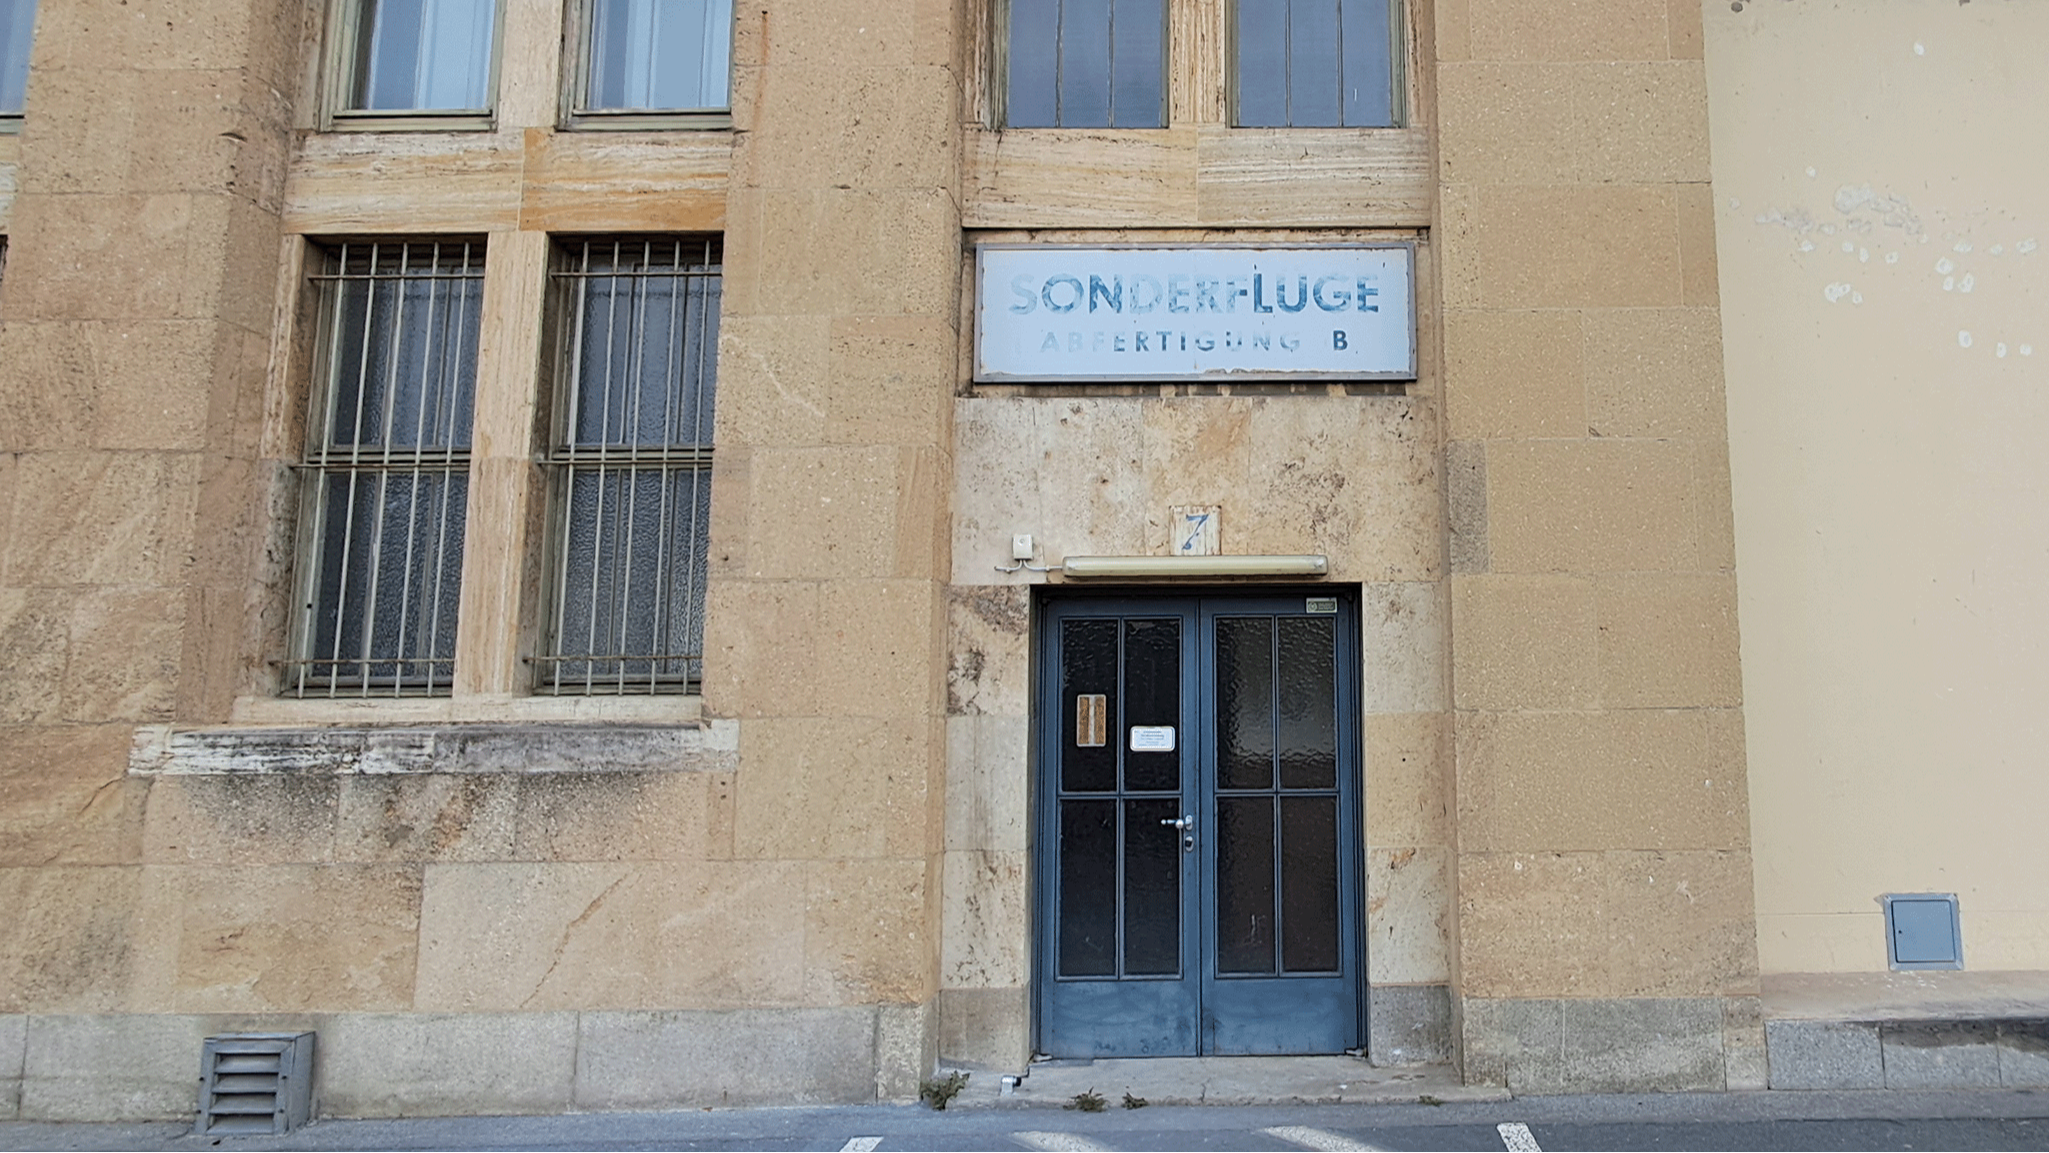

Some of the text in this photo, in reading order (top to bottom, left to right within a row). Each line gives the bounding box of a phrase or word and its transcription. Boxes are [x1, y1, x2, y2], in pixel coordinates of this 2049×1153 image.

[1040, 330, 1348, 351] ABFERTIGUNG B
[1182, 513, 1209, 550] 7
